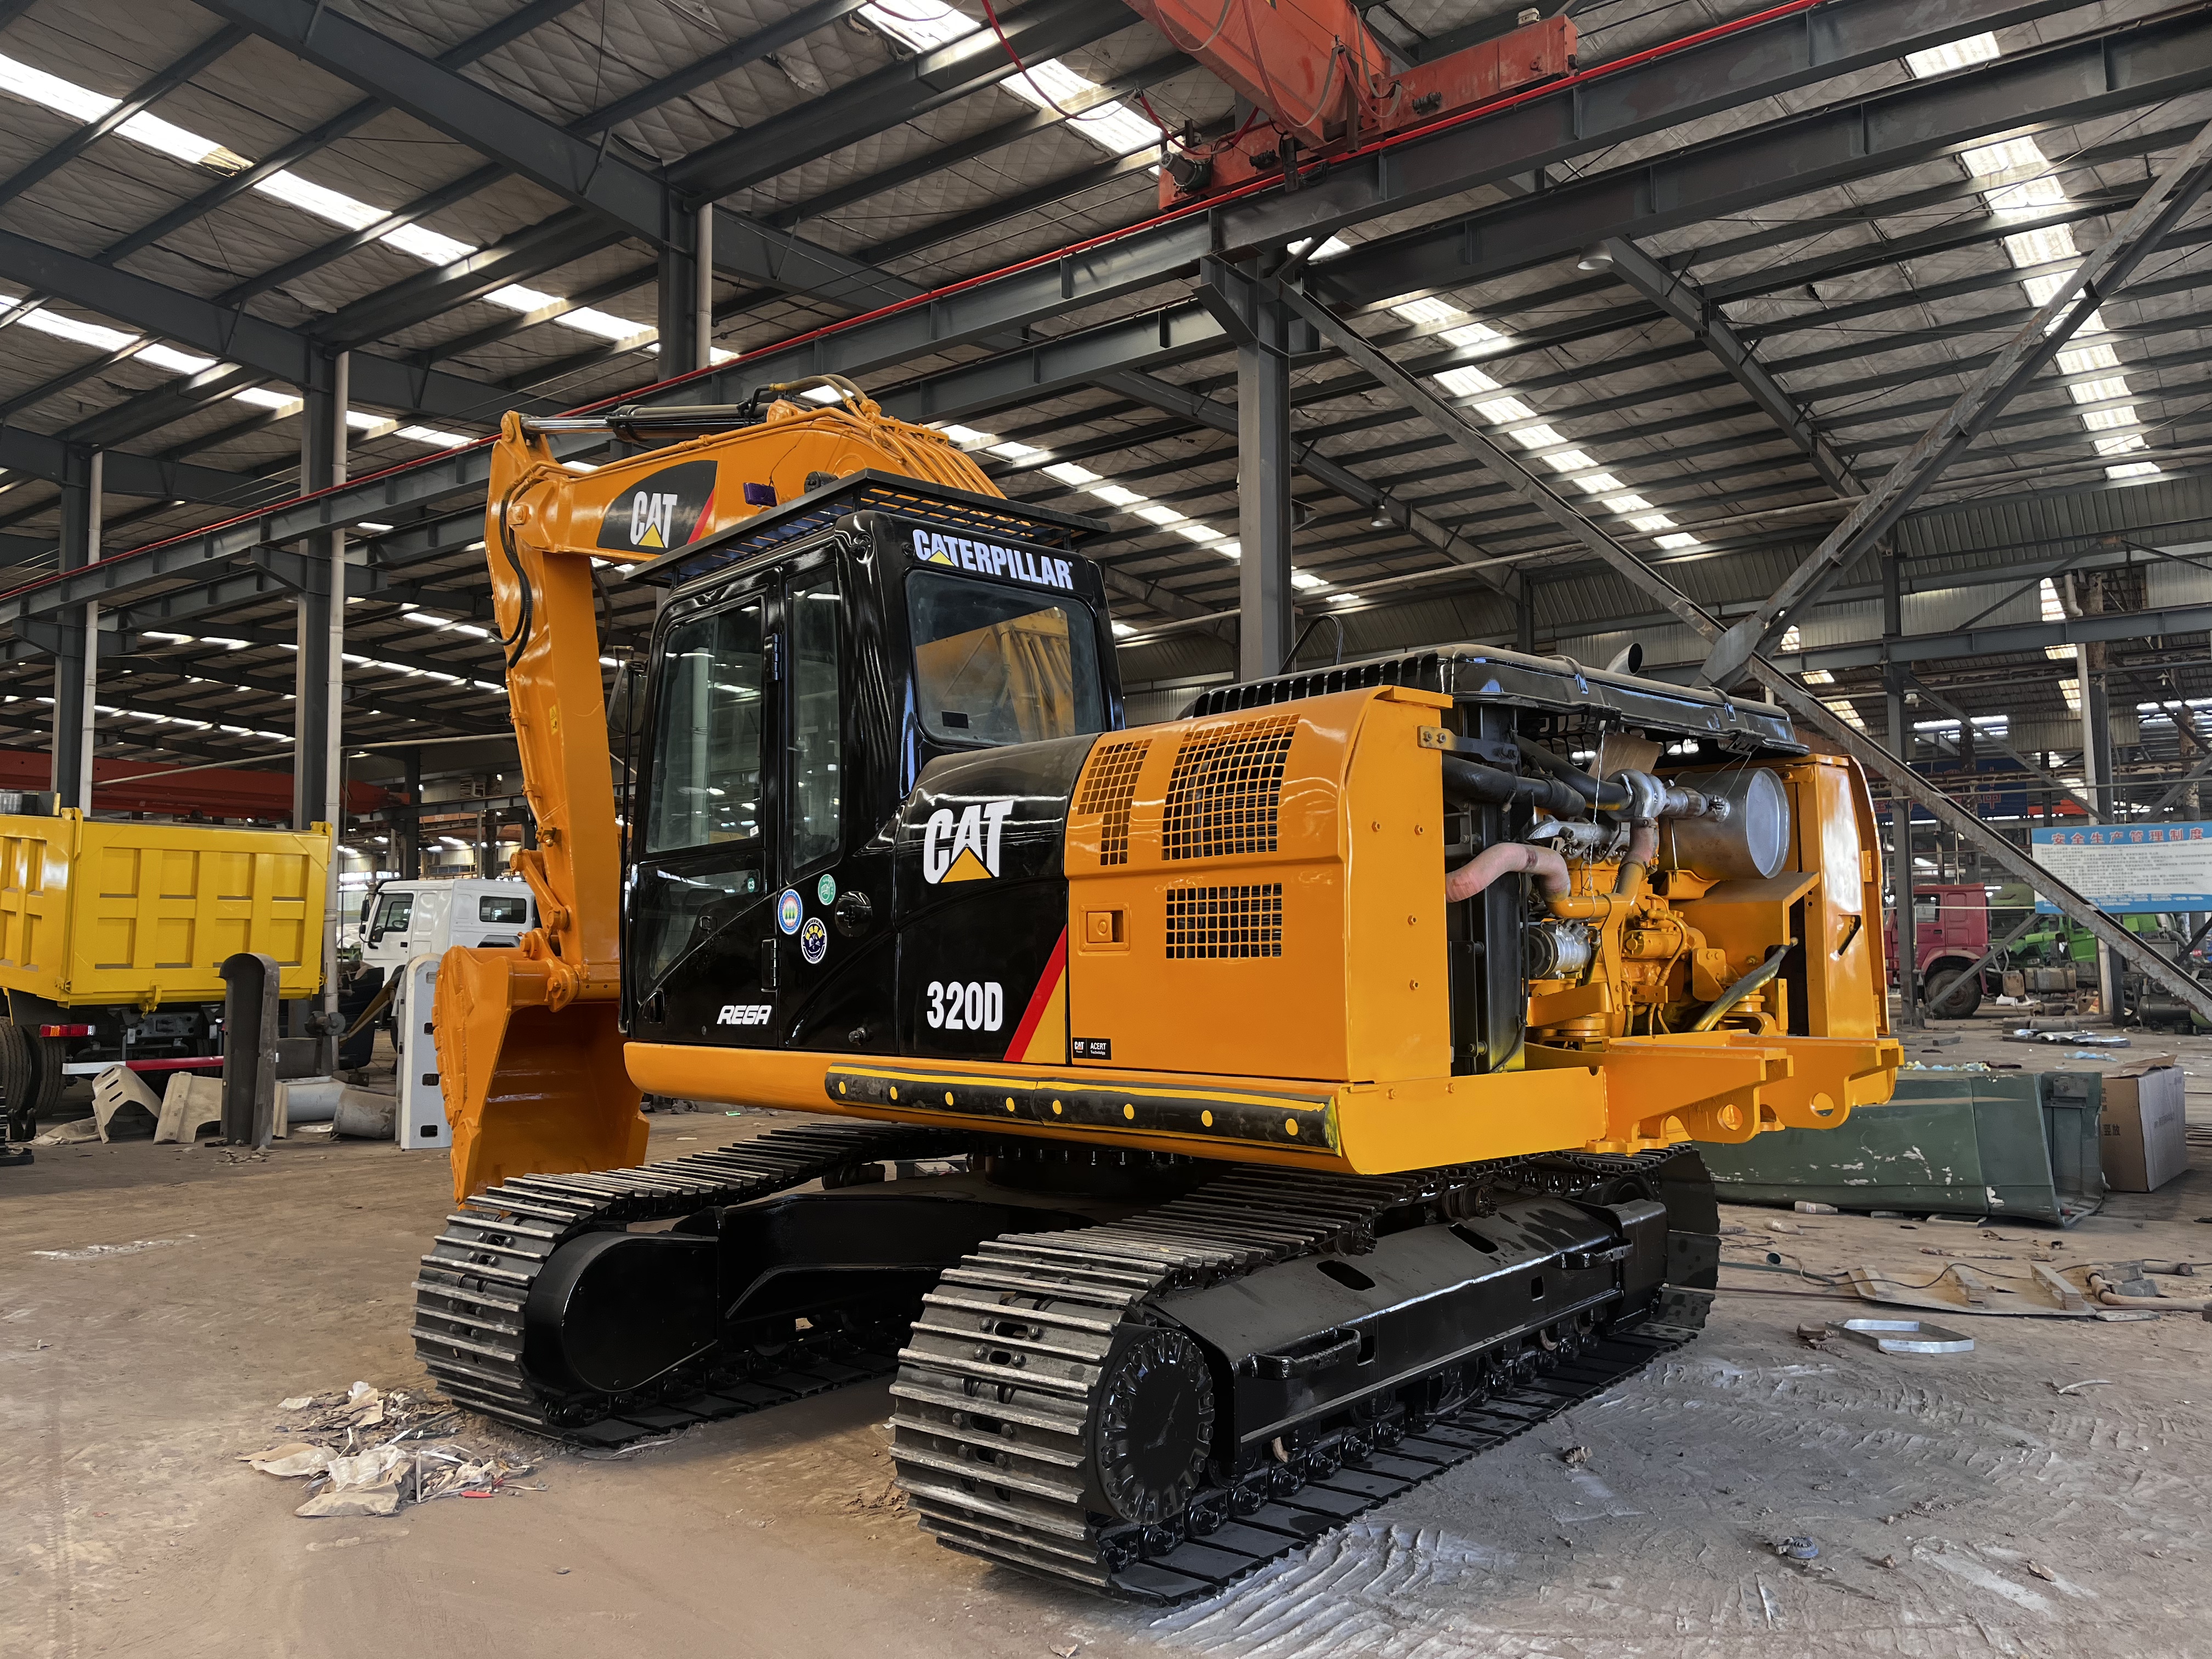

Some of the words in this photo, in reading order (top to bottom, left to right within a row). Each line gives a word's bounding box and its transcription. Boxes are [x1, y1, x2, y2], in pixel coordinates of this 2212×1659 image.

[630, 491, 678, 548] CAT
[912, 529, 1074, 590] CATERPILLAR
[923, 800, 1014, 884] CAT
[2051, 827, 2204, 845] 安全生产管理制度
[716, 1005, 772, 1025] REGA
[927, 981, 1003, 1031] 320D
[1074, 1041, 1084, 1050] CAT
[1090, 1042, 1107, 1051] ACERT
